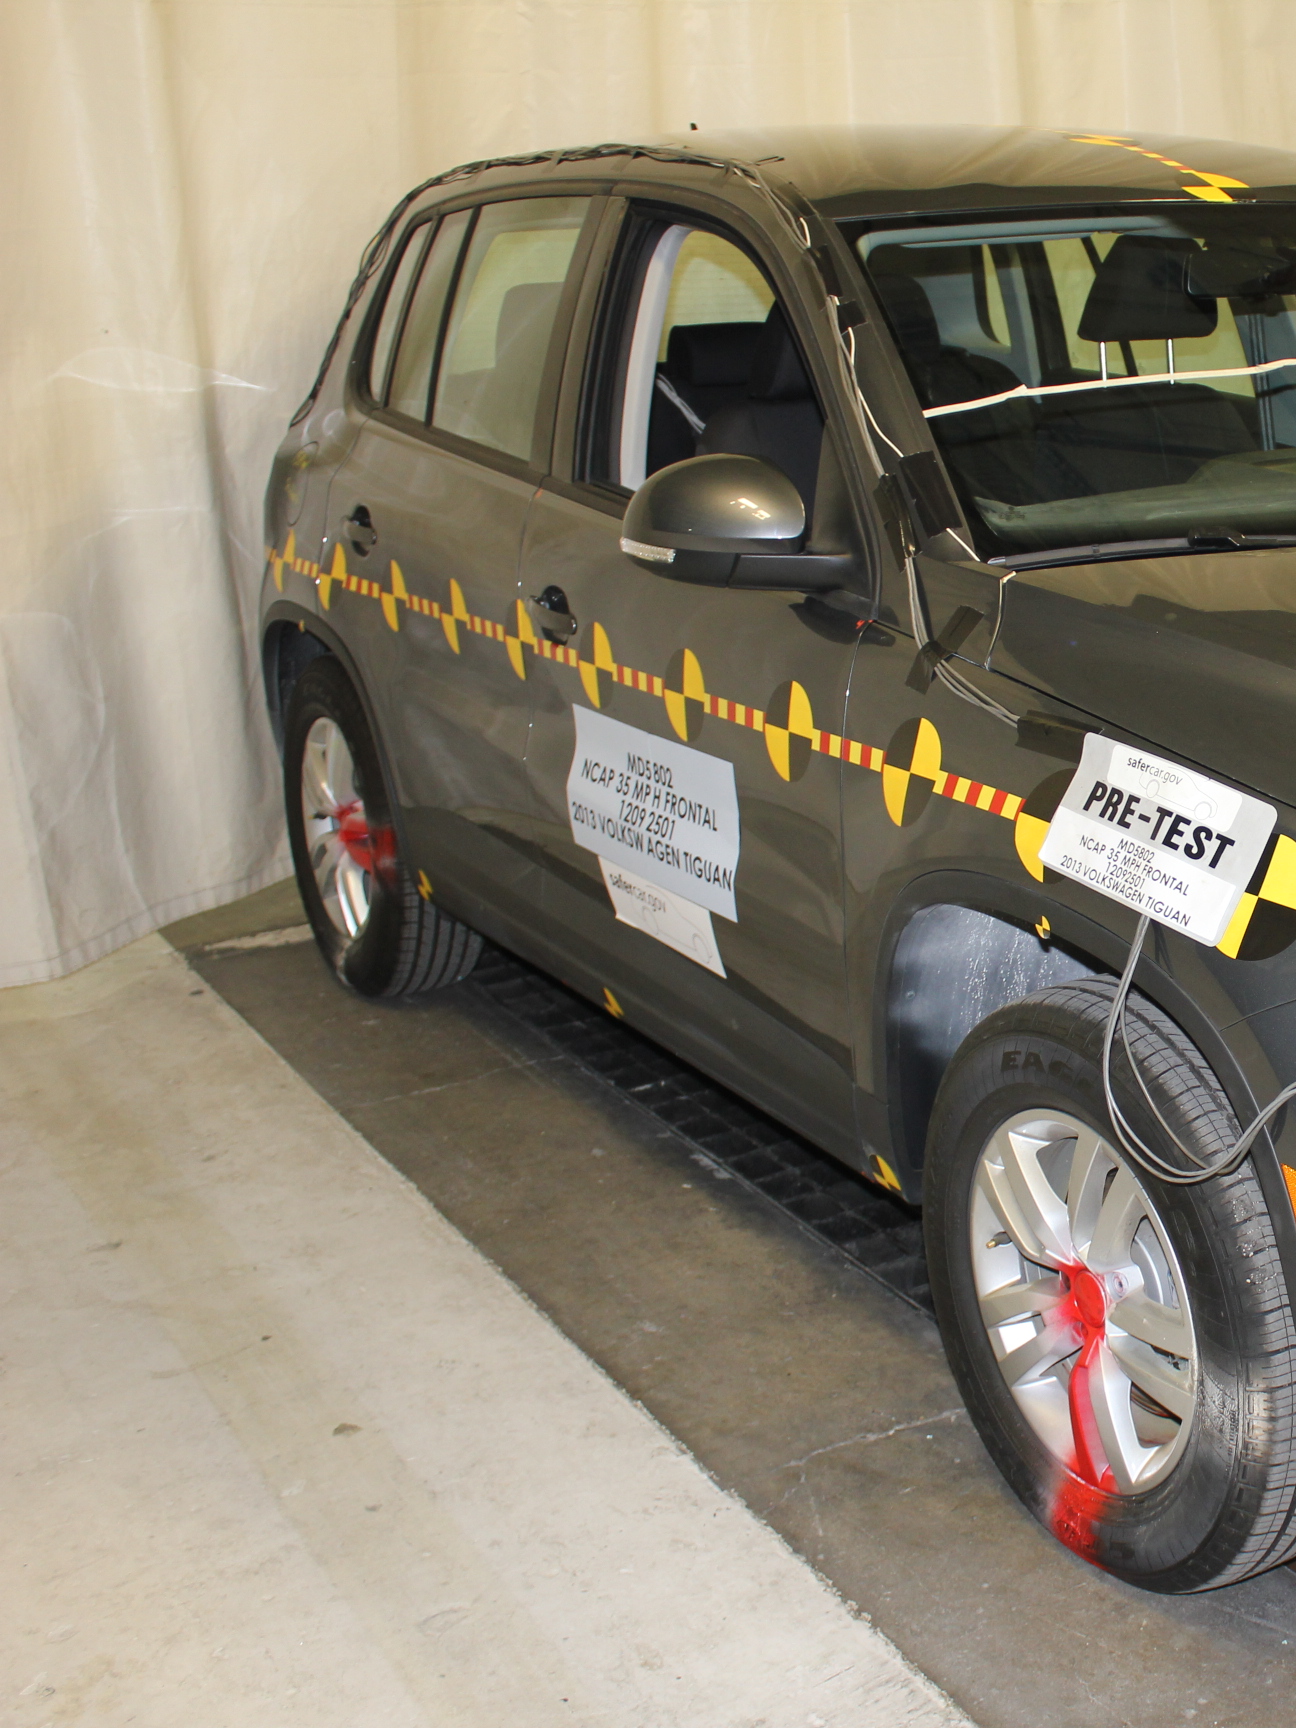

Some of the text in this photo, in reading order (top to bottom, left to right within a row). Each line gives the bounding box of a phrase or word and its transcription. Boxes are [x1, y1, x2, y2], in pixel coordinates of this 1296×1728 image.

[581, 758, 718, 831] NCAP 35 MPH FRONTAL
[627, 752, 674, 789] MD5802
[1127, 757, 1183, 785] safercar.gov
[572, 801, 597, 830] 2013
[683, 851, 733, 892] TIGUAN
[1082, 780, 1236, 870] PRE-TEST
[1117, 838, 1155, 864] MD5802
[1060, 854, 1191, 927] 2013 VOLKSWAGEN TIGUAN
[1079, 835, 1190, 897] NCAP 35 MPH FRONTAL
[1105, 862, 1146, 889] 12092501
